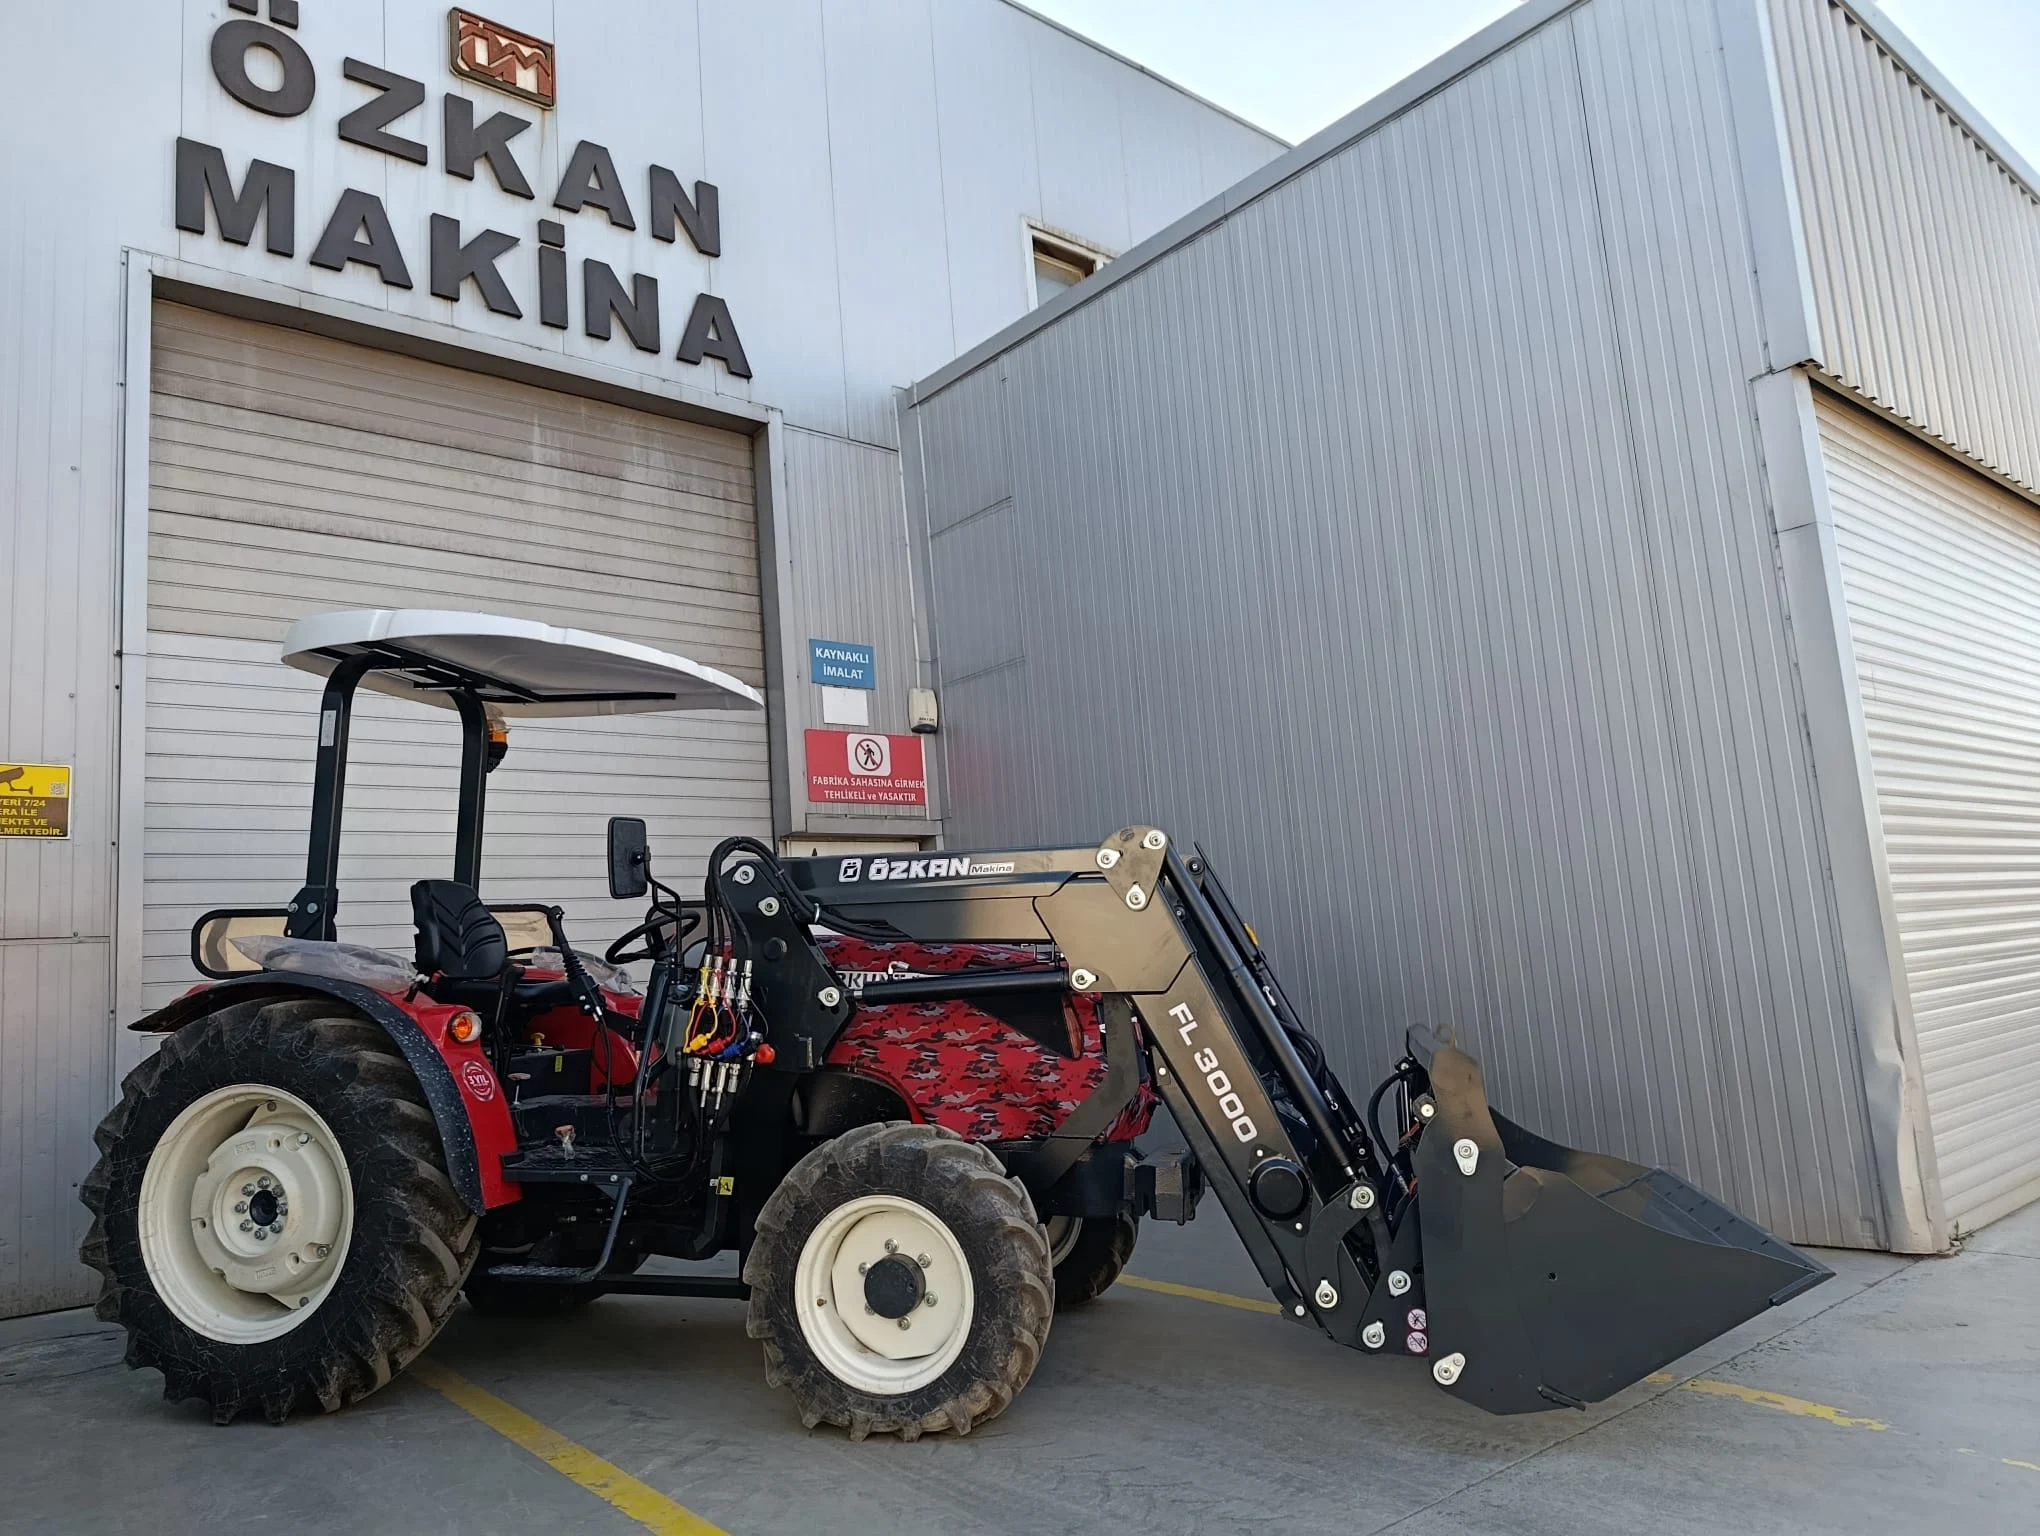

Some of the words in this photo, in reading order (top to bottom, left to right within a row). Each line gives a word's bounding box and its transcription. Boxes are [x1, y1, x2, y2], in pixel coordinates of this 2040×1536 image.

[211, 0, 721, 258] ÖZKAN
[175, 136, 753, 380] MAKİNA
[815, 647, 869, 664] KAYNAKLI
[823, 663, 864, 680] İMALAT
[812, 775, 849, 786] FABRİKA
[850, 777, 893, 788] SAHASINA
[894, 779, 925, 789] GİRMEK
[24, 799, 46, 807] 7/24
[824, 789, 866, 800] TEHLİKELİ
[878, 792, 917, 802] YASAKTIR
[20, 808, 38, 816] İLE
[0, 818, 31, 826] EKTE
[33, 818, 48, 826] VE
[868, 857, 971, 881] ÖZKAN
[971, 863, 1013, 875] Makina
[1168, 1002, 1198, 1047] FL
[1193, 1047, 1258, 1143] 3000
